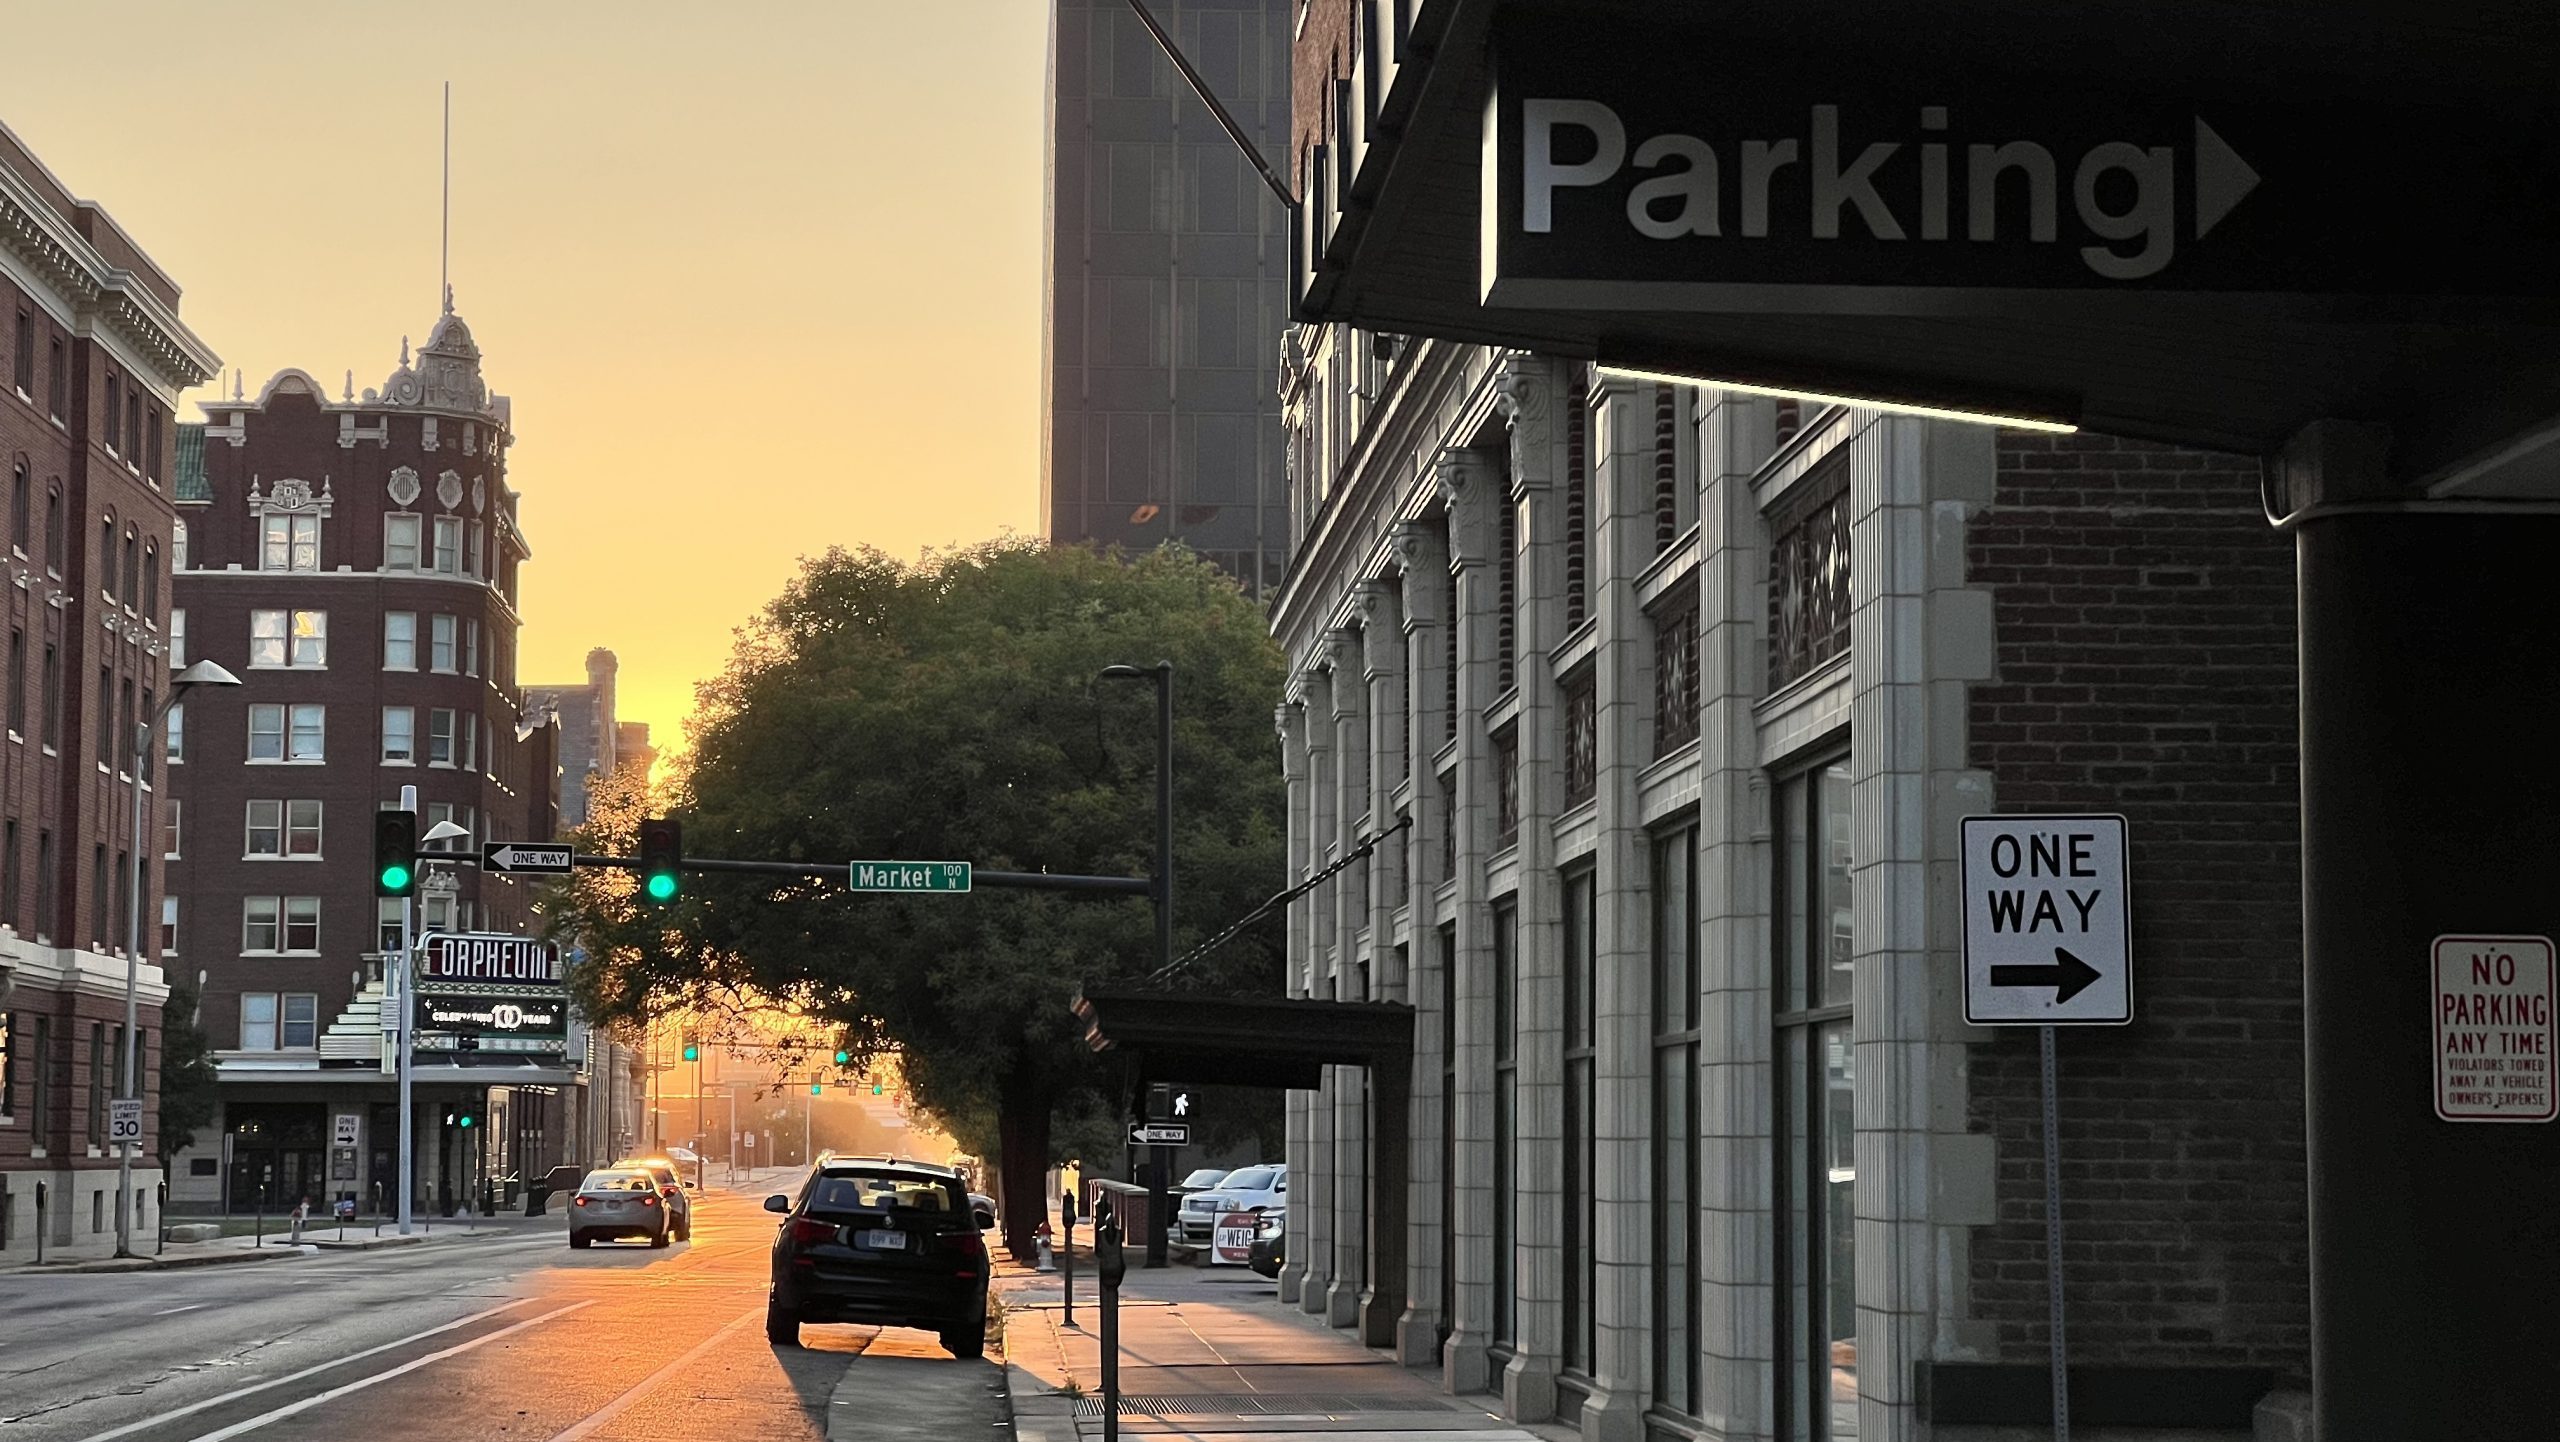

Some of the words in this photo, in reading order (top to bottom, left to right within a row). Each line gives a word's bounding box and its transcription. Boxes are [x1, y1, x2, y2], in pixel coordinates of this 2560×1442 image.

[1522, 98, 2175, 280] Parking
[512, 852, 537, 864] ONE
[541, 853, 566, 865] WAY
[1990, 833, 2097, 878] ONE
[859, 865, 932, 888] Market
[943, 864, 962, 877] 100
[948, 877, 956, 889] N
[1988, 889, 2101, 933] WAY
[441, 939, 548, 980] ORPHEUM
[2472, 953, 2516, 986] NO
[491, 1004, 523, 1029] 100
[523, 1013, 551, 1026] YEARS
[2443, 993, 2547, 1026] PARKING
[2446, 1032, 2488, 1054] ANY
[2499, 1032, 2546, 1055] TIME
[2448, 1058, 2505, 1072] VIOLATORS
[2510, 1058, 2545, 1072] TOWED
[2449, 1075, 2477, 1088] AWAY
[2483, 1075, 2497, 1088] AT
[2502, 1075, 2545, 1089] VEHICLE
[2449, 1091, 2493, 1105] OWNER'S
[2498, 1092, 2546, 1106] EXPENSE
[113, 1120, 138, 1136] 30
[338, 1117, 356, 1126] ONE
[1147, 1130, 1163, 1138] ONE
[1165, 1130, 1182, 1139] WAY
